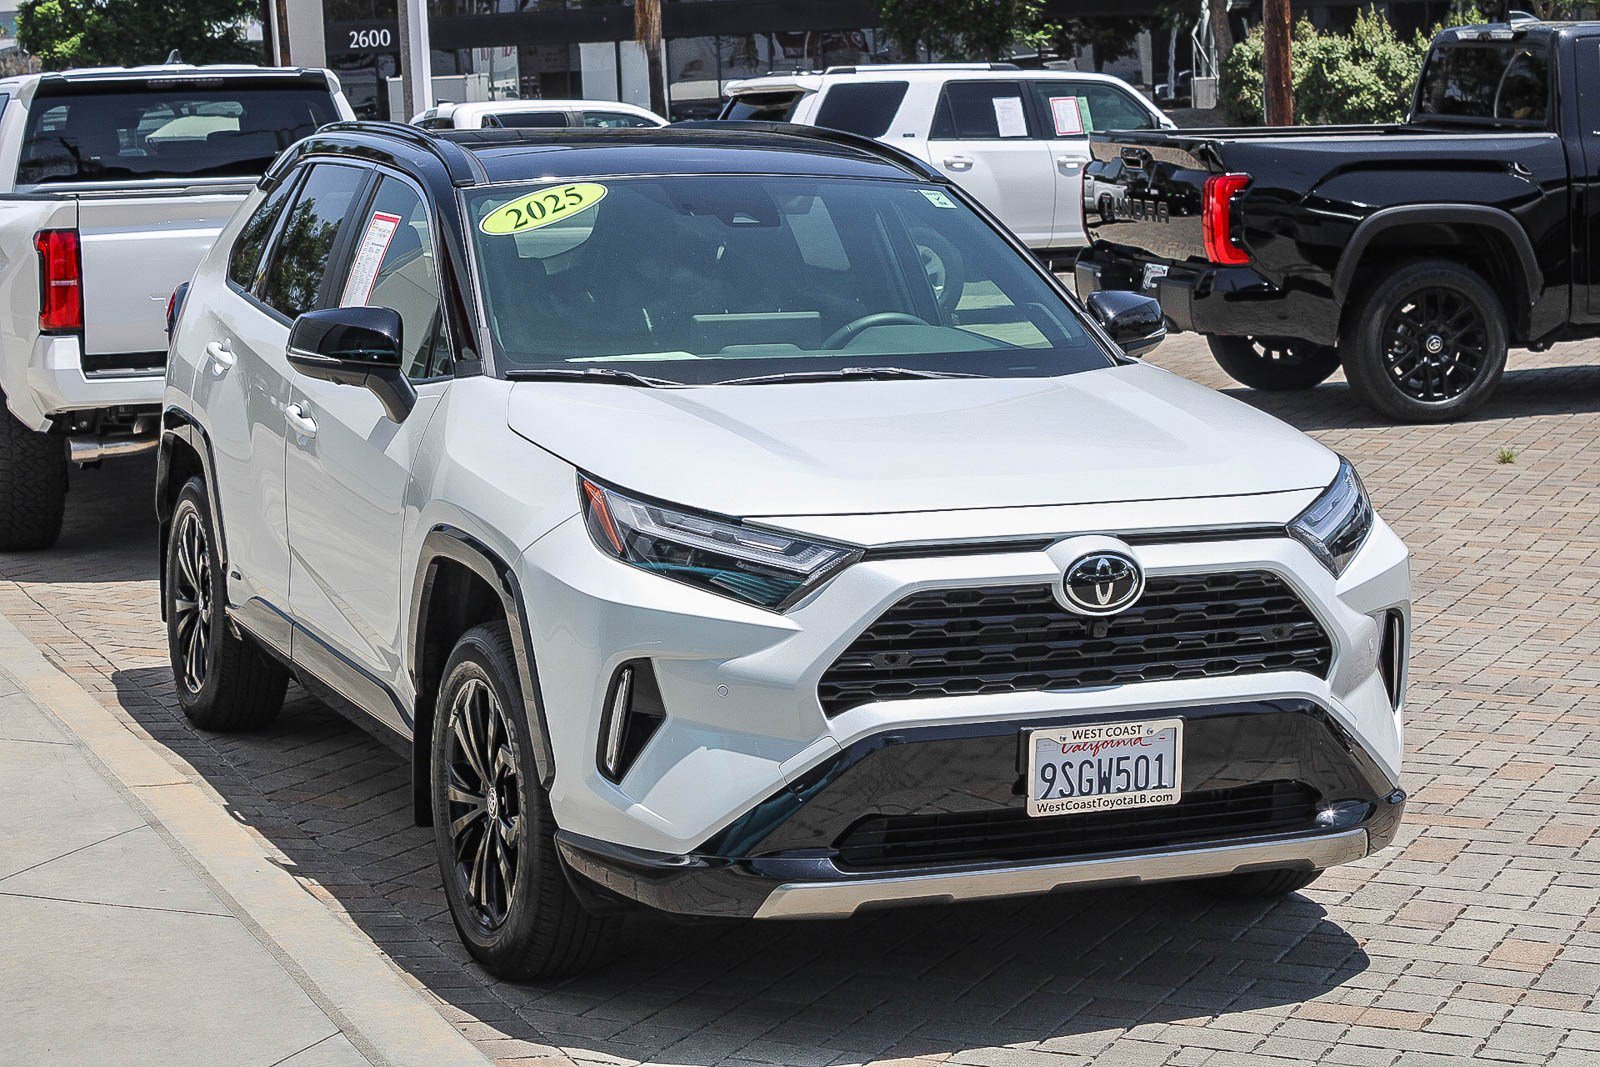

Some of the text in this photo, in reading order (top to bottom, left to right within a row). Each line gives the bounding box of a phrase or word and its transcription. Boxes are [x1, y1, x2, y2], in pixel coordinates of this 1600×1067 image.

[349, 29, 391, 48] 2600
[505, 187, 583, 229] 2025
[1101, 194, 1169, 223] TUNDRA
[1072, 725, 1143, 740] WEST COAST
[1061, 737, 1152, 757] California
[1040, 753, 1168, 800] 9SGW501
[1036, 793, 1173, 813] WestCoastToyotaLB.com
